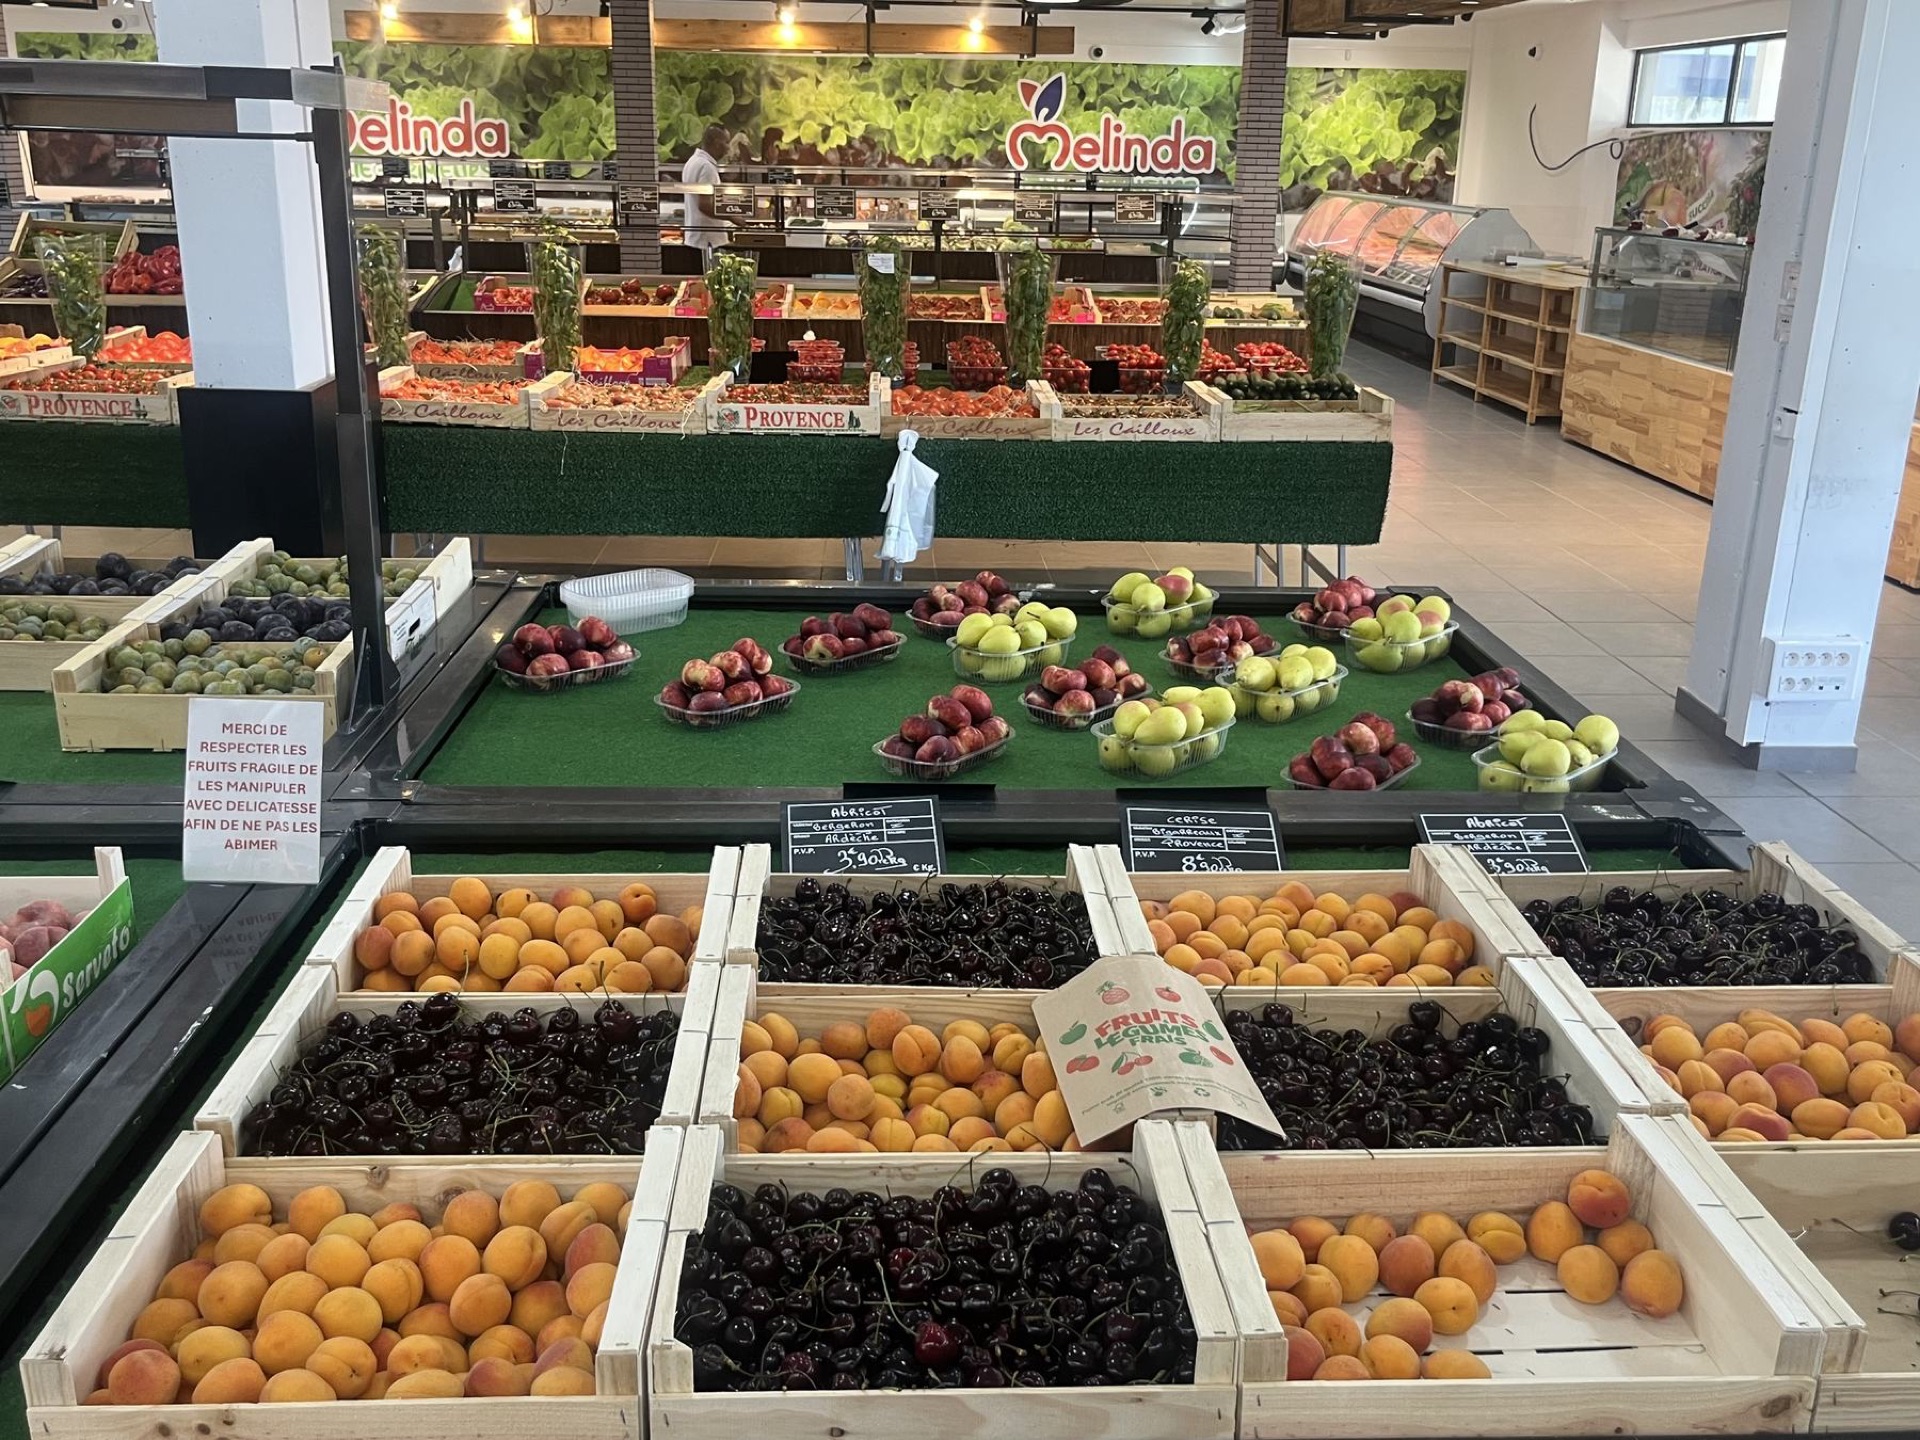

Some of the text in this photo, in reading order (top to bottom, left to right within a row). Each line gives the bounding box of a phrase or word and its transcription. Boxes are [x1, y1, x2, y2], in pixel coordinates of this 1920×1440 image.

[347, 97, 507, 154] elinda
[1009, 113, 1214, 172] Melinda
[25, 394, 133, 416] PROVENCE
[414, 404, 504, 420] Cailloux
[593, 413, 680, 429] Cailloux
[743, 406, 845, 430] PROVENCE
[942, 420, 1031, 436] Cailloux
[1074, 422, 1196, 436] Les Cailloux
[222, 723, 288, 736] MERCI DE
[200, 741, 307, 756] RESPECTER LES
[188, 760, 318, 776] FRUITS FRAGILE DE
[198, 780, 306, 795] LES MANIPULER
[186, 799, 317, 814] AVEC DELICATESSE
[184, 818, 318, 833] AFIN DE NE PAS LES
[812, 821, 875, 833] Bergeron
[224, 838, 278, 851] ABIMER
[1095, 1008, 1199, 1038] FRUITS
[1129, 1034, 1187, 1047] FRAIS
